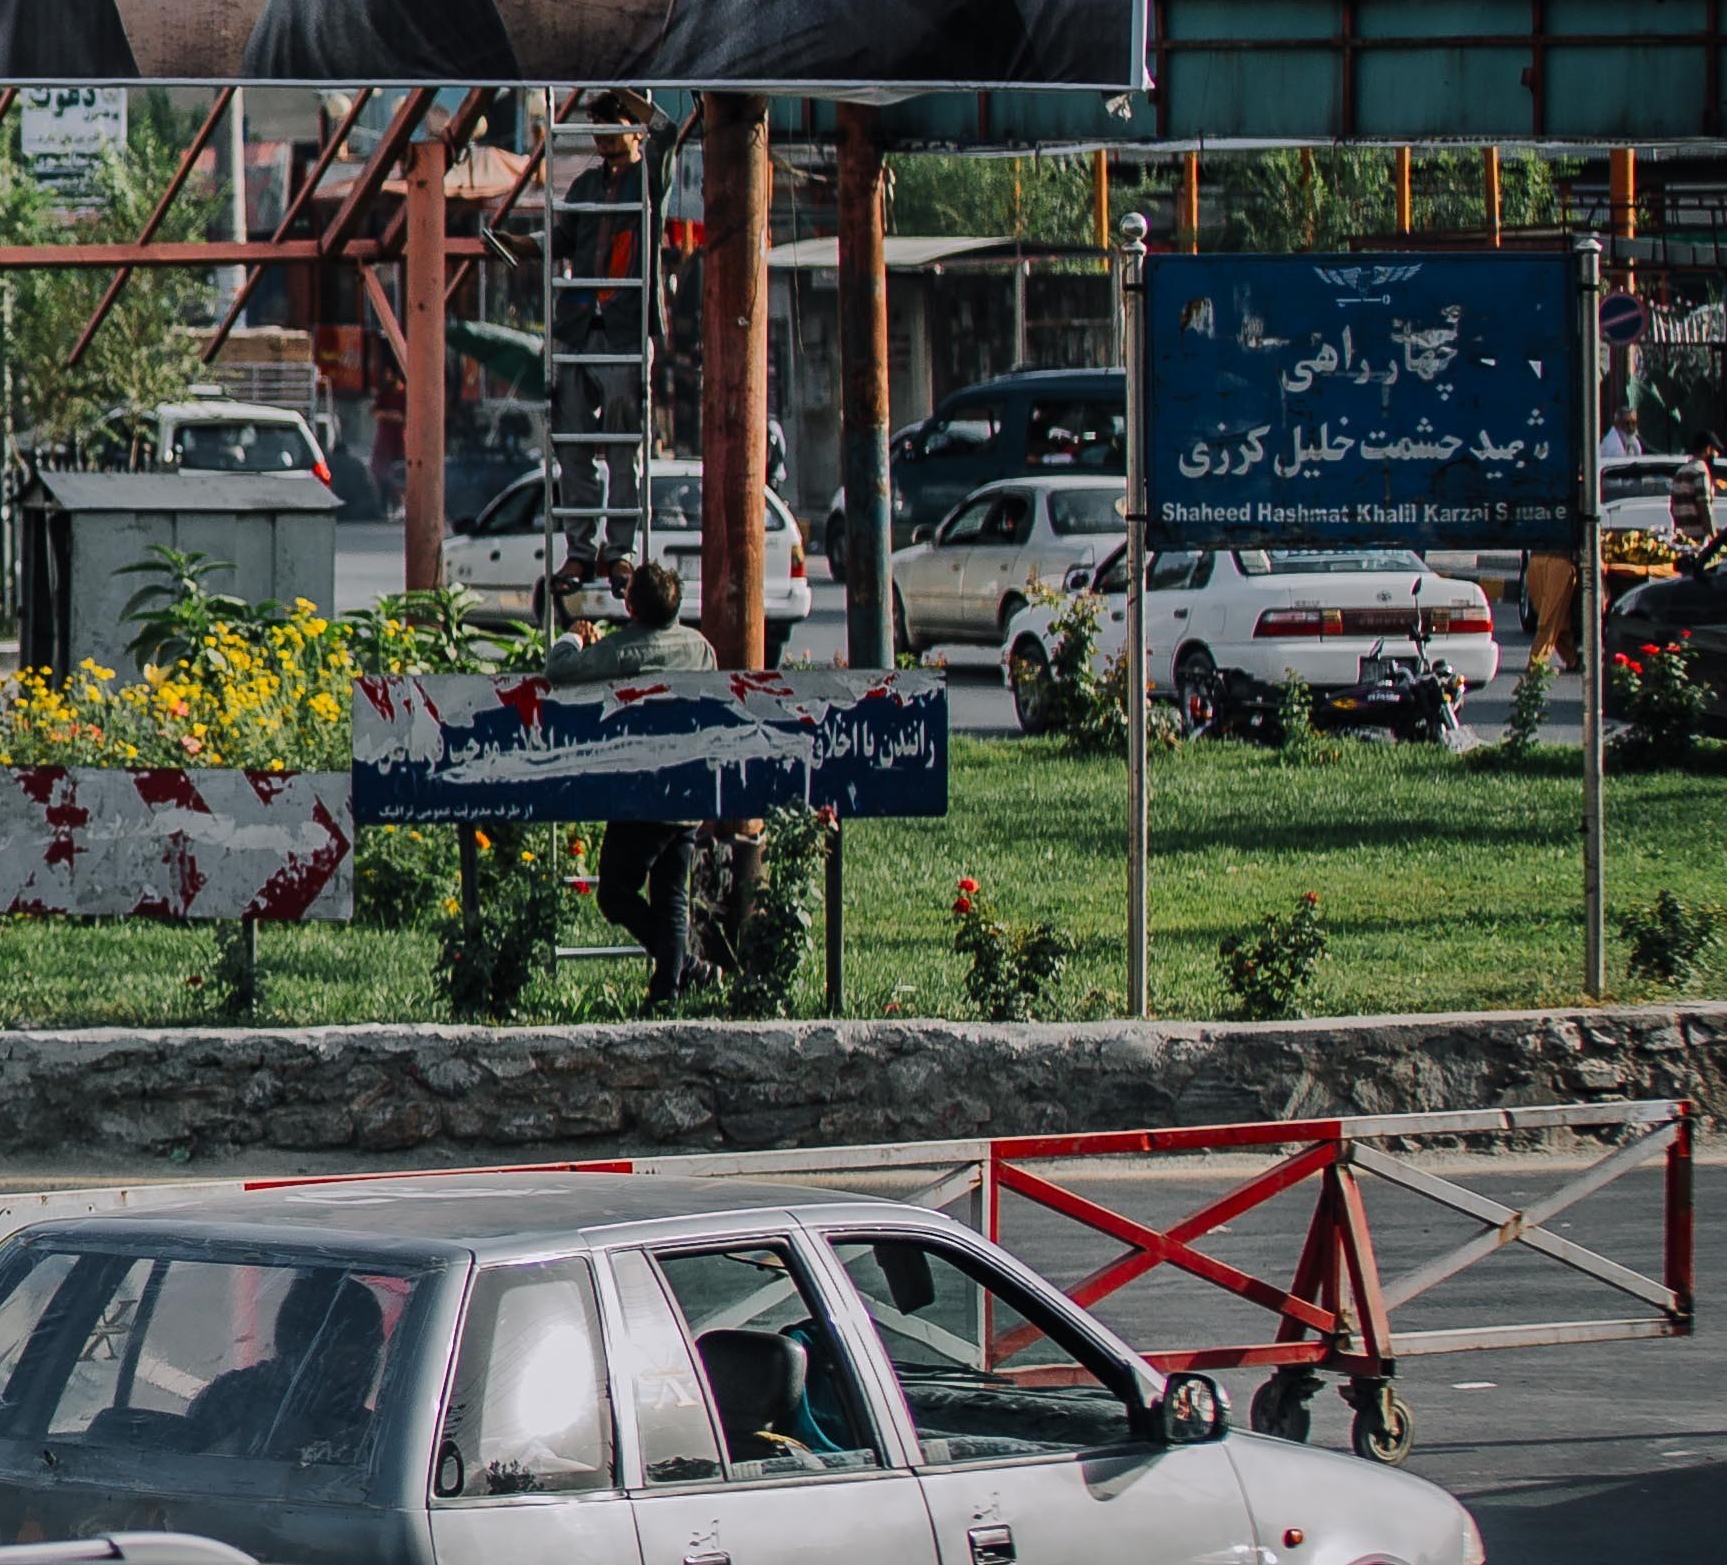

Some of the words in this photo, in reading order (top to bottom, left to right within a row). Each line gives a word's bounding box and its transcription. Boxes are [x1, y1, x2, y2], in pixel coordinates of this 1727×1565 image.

[1273, 416, 1355, 479] خلیل
[1360, 417, 1463, 461] حشمت
[1162, 502, 1251, 523] Shaheed
[1258, 502, 1349, 524] Hashmat
[1357, 503, 1416, 524] Khalil
[1424, 503, 1489, 524] Karzai
[494, 804, 521, 818] طرف
